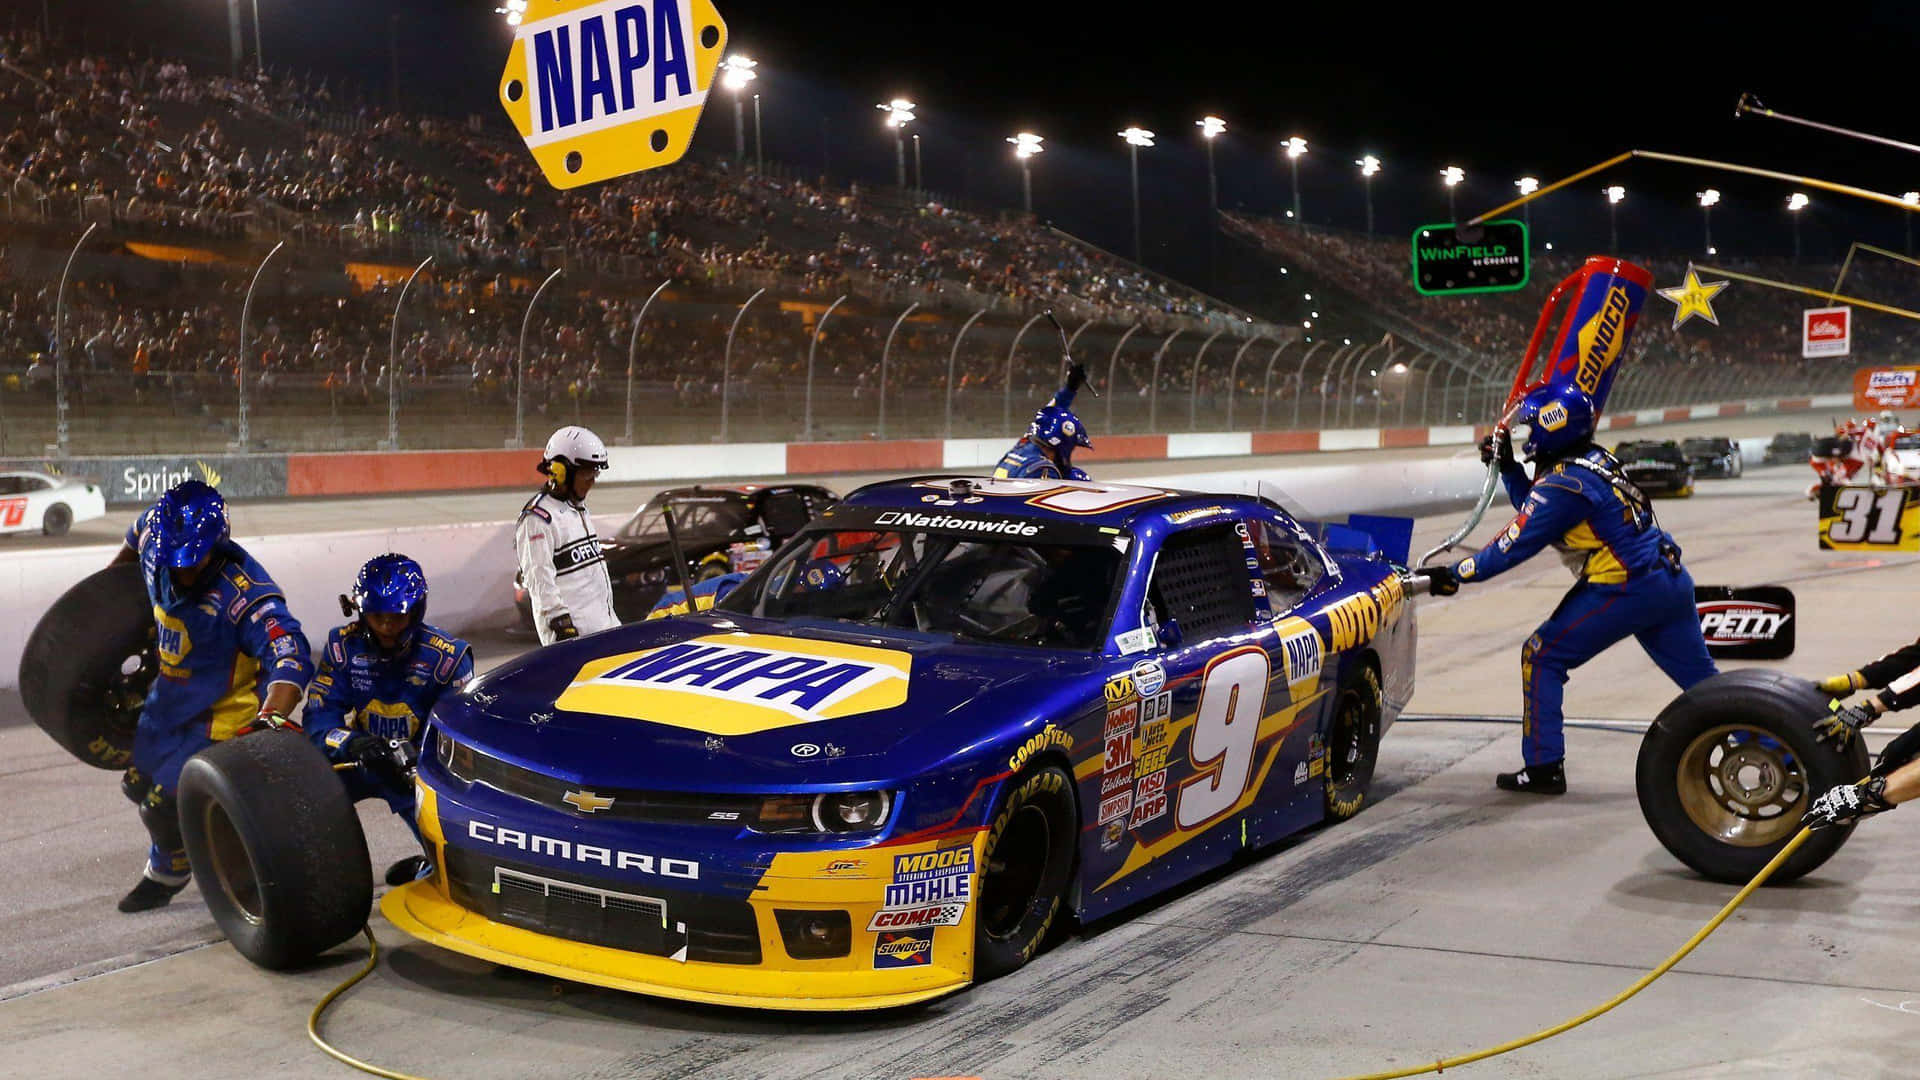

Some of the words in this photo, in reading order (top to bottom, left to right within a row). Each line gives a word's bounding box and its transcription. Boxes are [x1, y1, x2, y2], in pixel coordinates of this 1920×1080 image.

[534, 0, 692, 132] NAPA
[1580, 294, 1628, 392] SUNOCO
[1542, 410, 1566, 425] NAPA
[124, 466, 192, 500] Sprint
[895, 512, 1040, 537] Nationwide
[1829, 488, 1907, 545] 31
[1328, 594, 1378, 654] AUTO
[1701, 613, 1790, 634] PETTY
[429, 636, 455, 655] NAPA
[1287, 633, 1320, 681] NAPA
[601, 644, 874, 711] NAPA
[368, 713, 409, 740] NAPA
[1107, 707, 1137, 731] Holley
[1105, 732, 1132, 770] 3M
[1176, 647, 1270, 830] 9
[1135, 747, 1168, 778] JEGS
[1138, 771, 1165, 796] MSD
[708, 811, 740, 820] SS
[1101, 795, 1130, 820] SIMPSON
[1130, 795, 1166, 827] ARP
[469, 820, 699, 880] CAMARO
[896, 847, 972, 874] MOOG
[885, 874, 969, 906] MAHLE
[875, 906, 942, 927] COMP
[880, 941, 928, 953] SUNOCO
